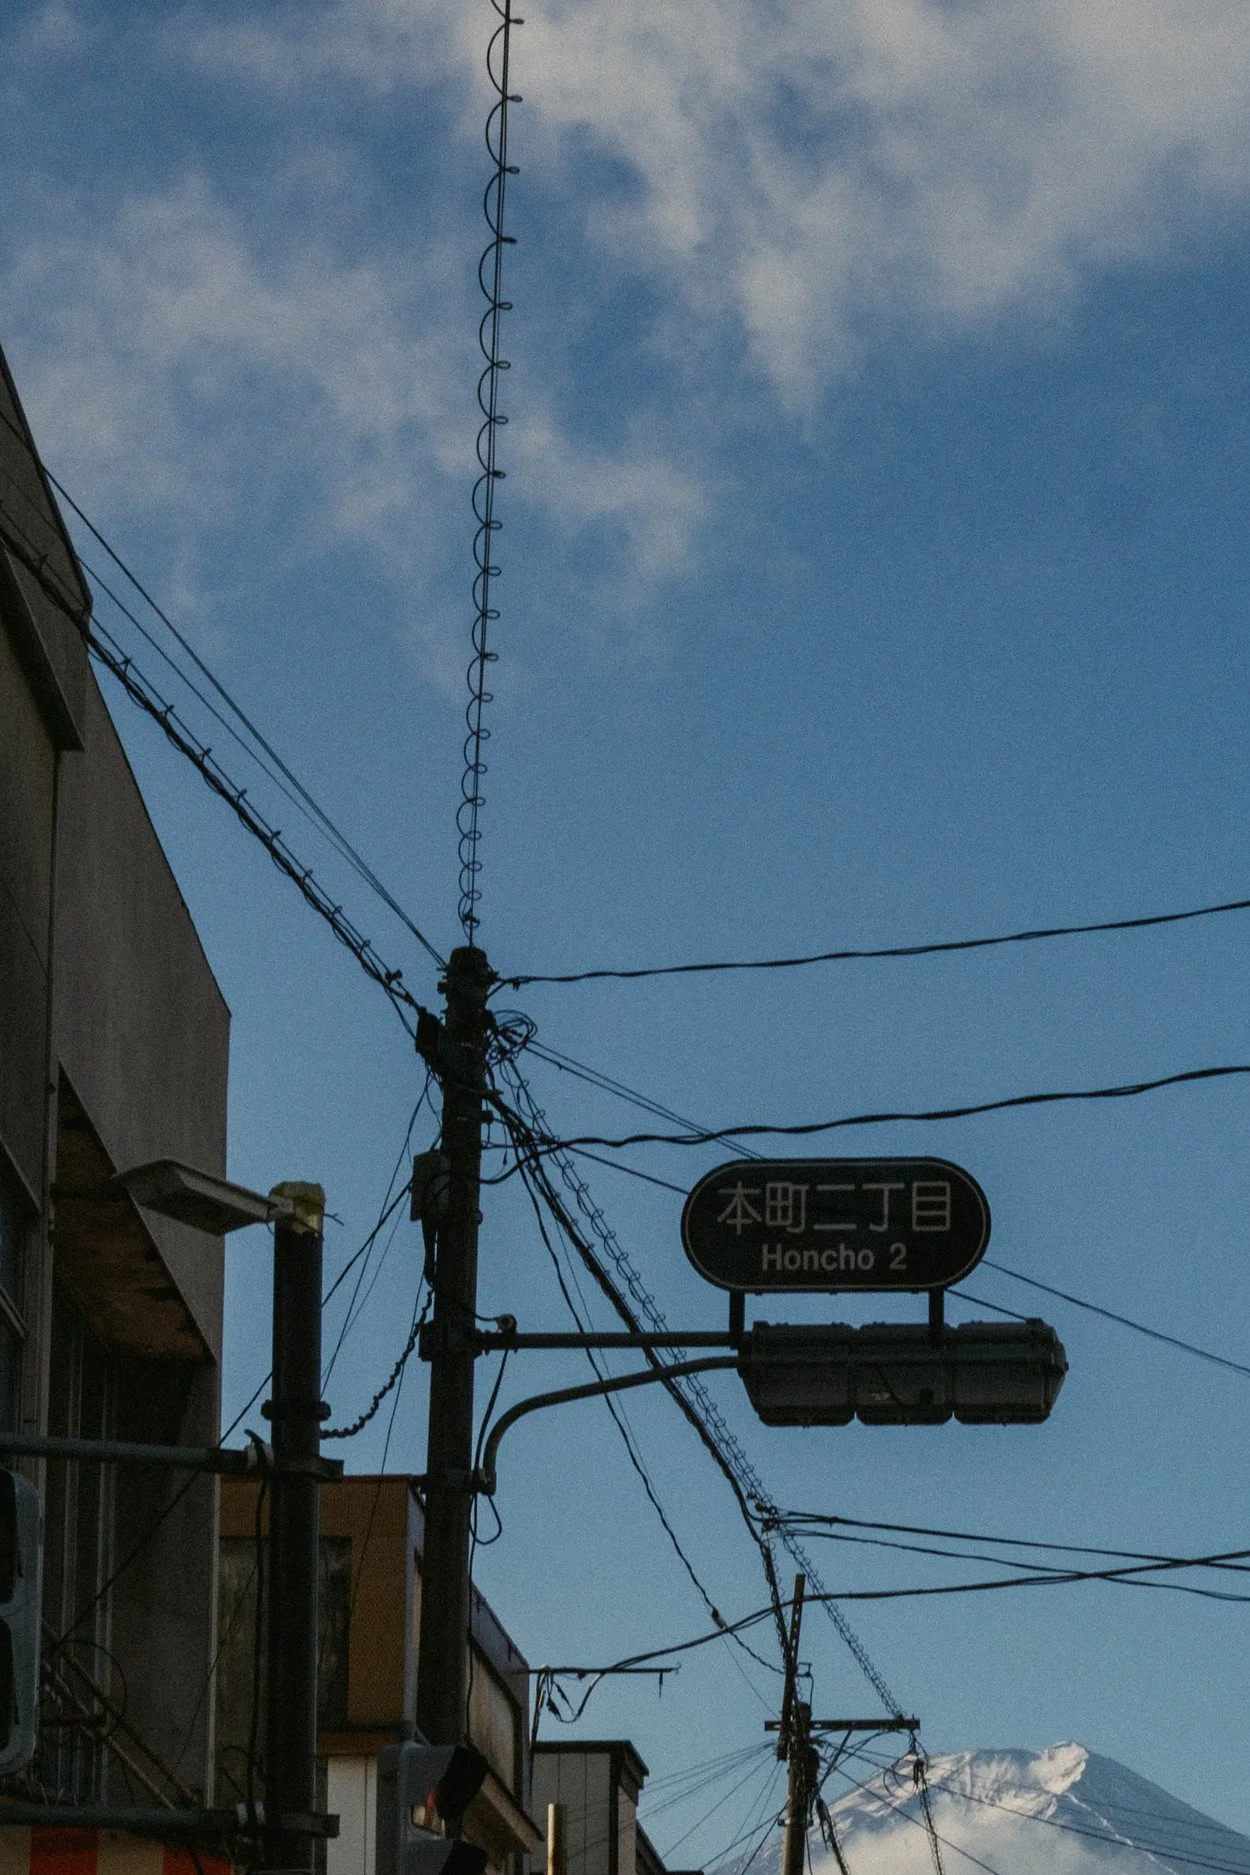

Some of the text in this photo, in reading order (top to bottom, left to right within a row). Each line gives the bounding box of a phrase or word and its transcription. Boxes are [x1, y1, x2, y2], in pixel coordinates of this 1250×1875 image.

[716, 1180, 952, 1236] 本町二丁目
[761, 1242, 908, 1272] Honcho 2
